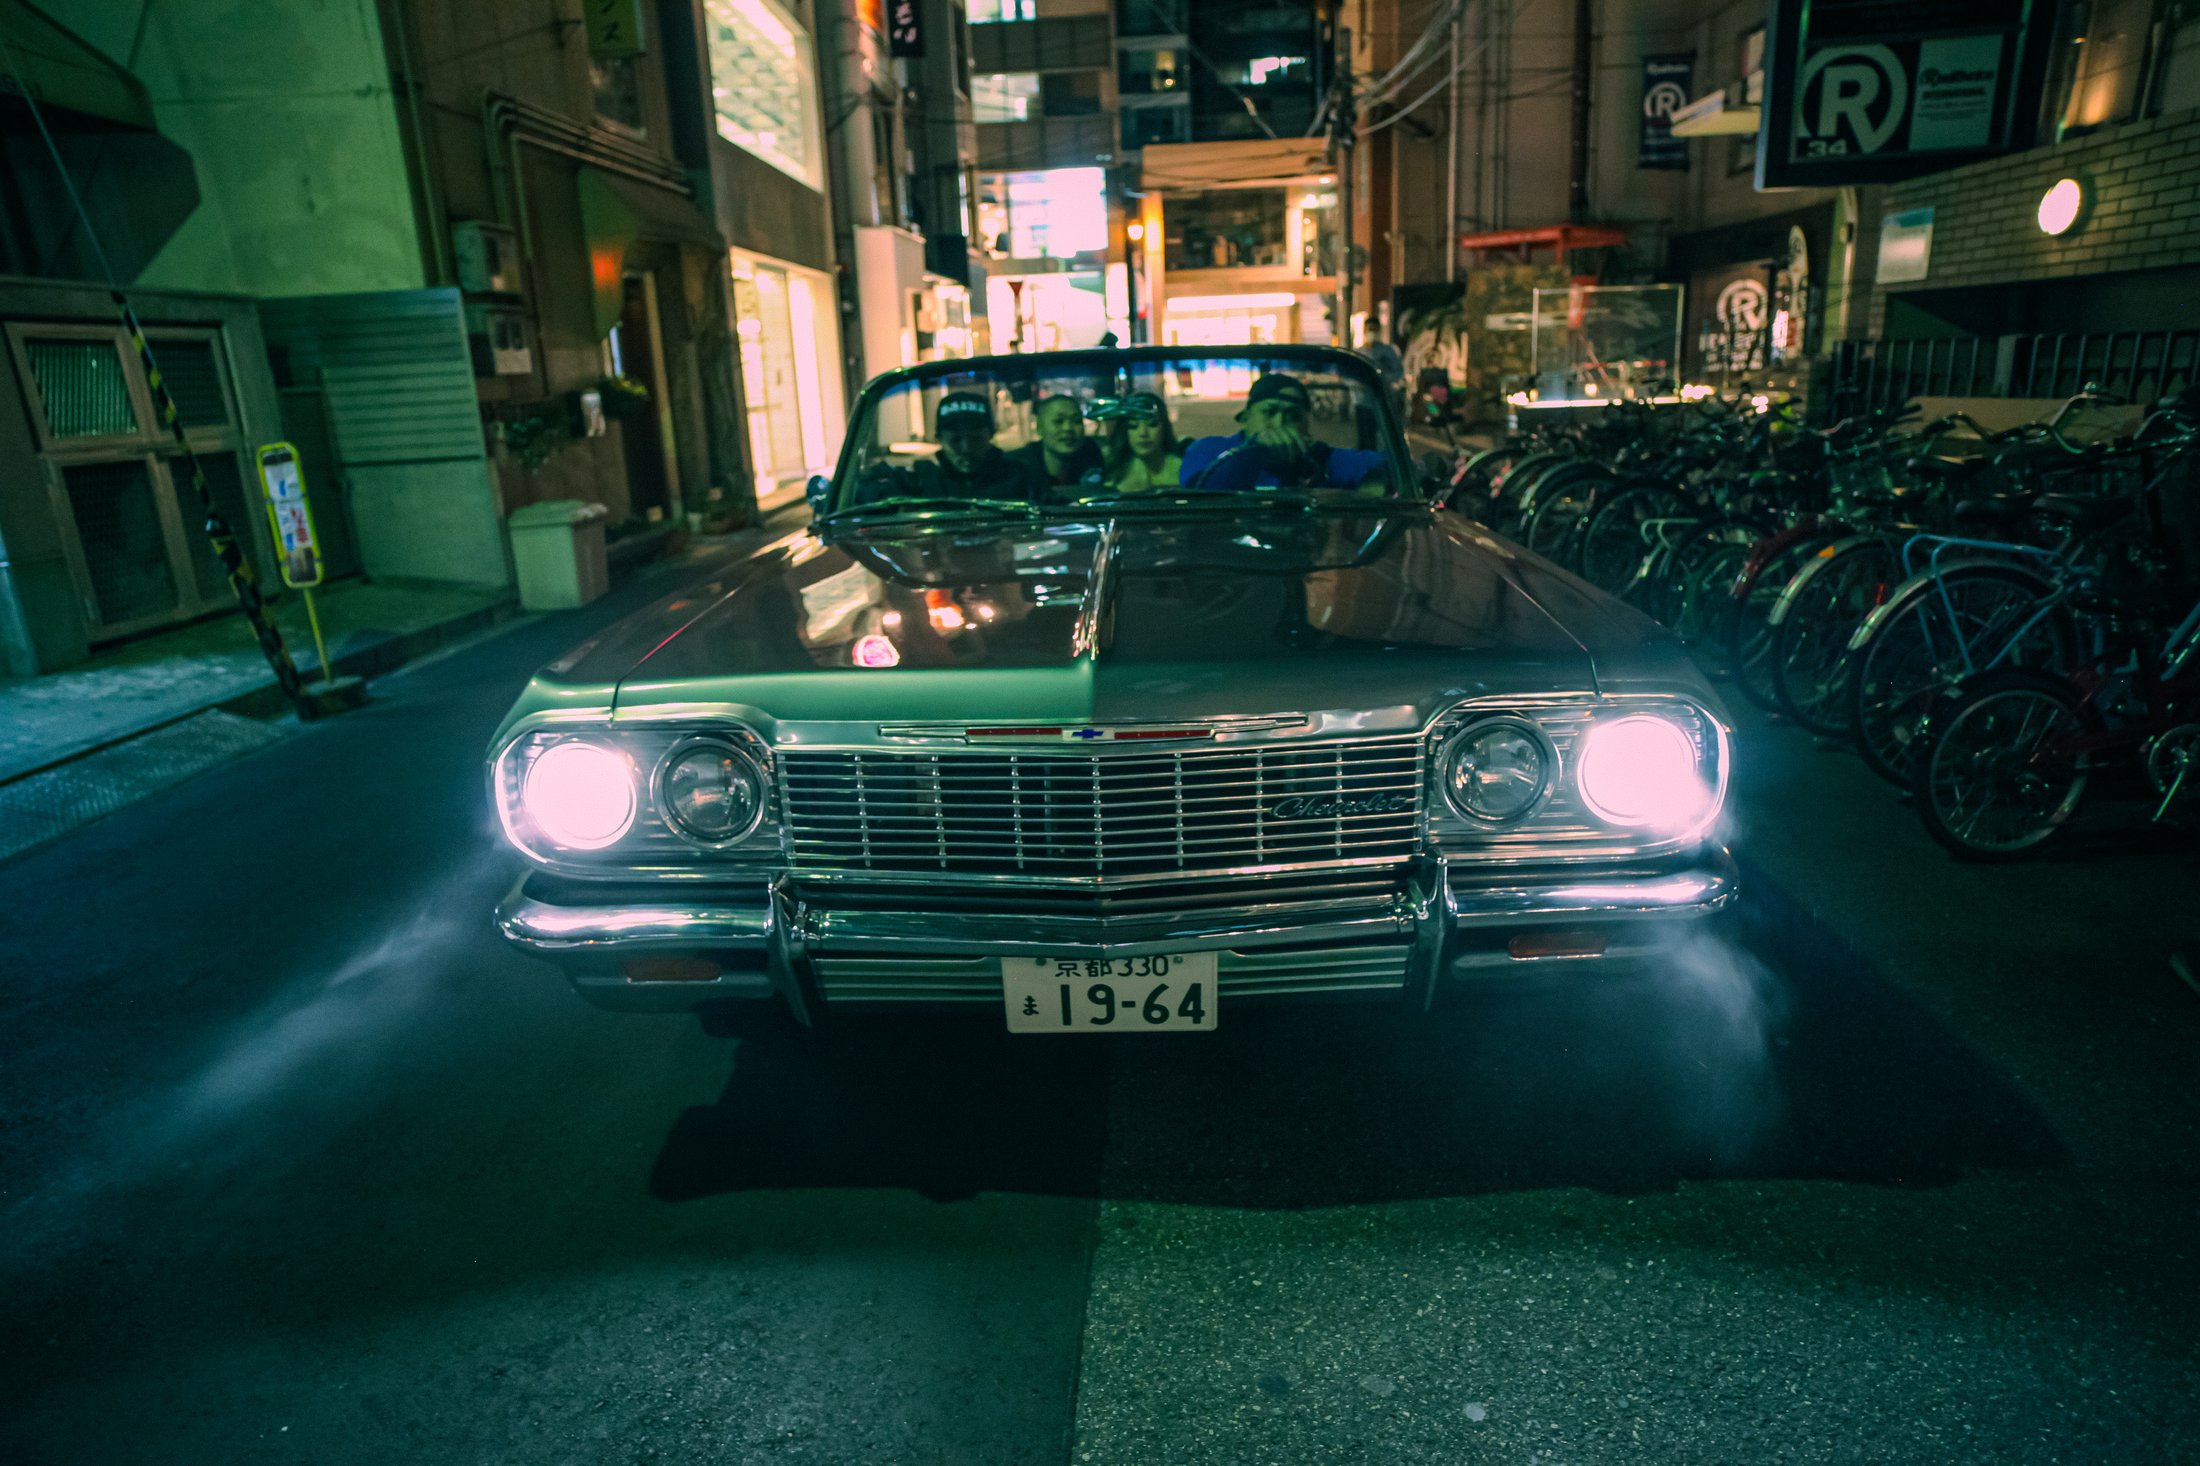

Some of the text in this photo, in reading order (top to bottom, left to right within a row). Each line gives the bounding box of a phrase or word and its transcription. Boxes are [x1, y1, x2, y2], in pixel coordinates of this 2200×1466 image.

[1273, 793, 1406, 818] Chevrolet
[1022, 982, 1206, 1027] ま 19-64
